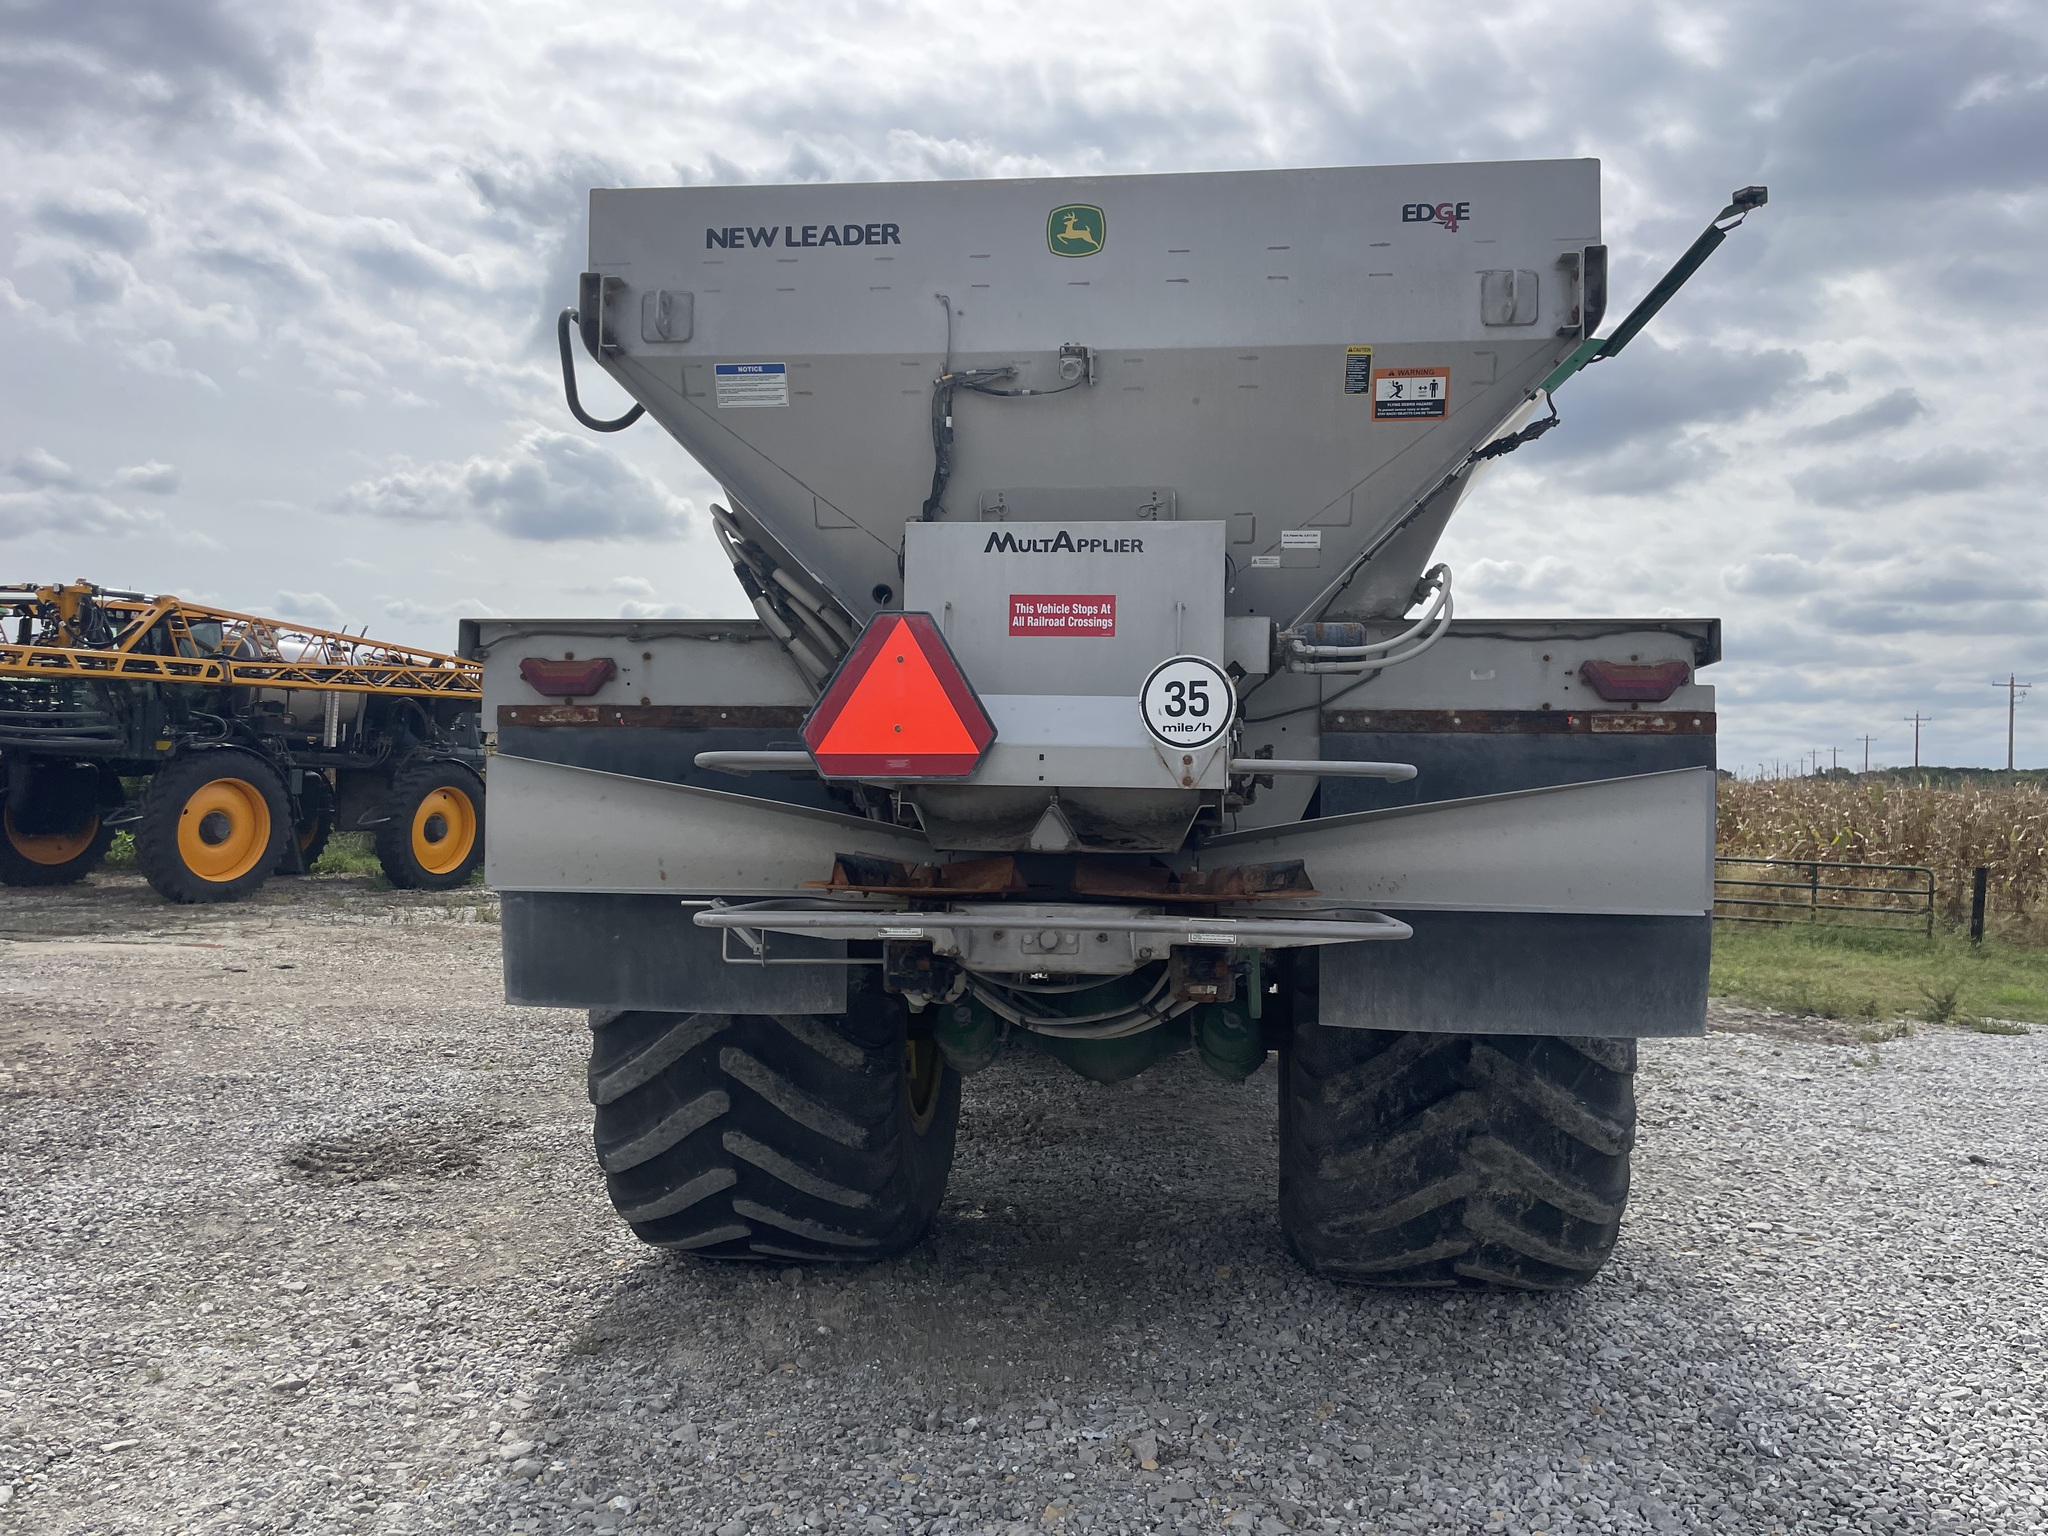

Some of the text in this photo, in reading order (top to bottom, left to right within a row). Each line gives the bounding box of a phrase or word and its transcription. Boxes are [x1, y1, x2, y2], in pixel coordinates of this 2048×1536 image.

[706, 223, 901, 249] NEW LEADER
[1015, 603, 1111, 616] This Vehicle Stops At
[1012, 616, 1113, 629] All Railroad Crossings
[1164, 680, 1210, 718] 35
[1162, 722, 1212, 732] mile/h
